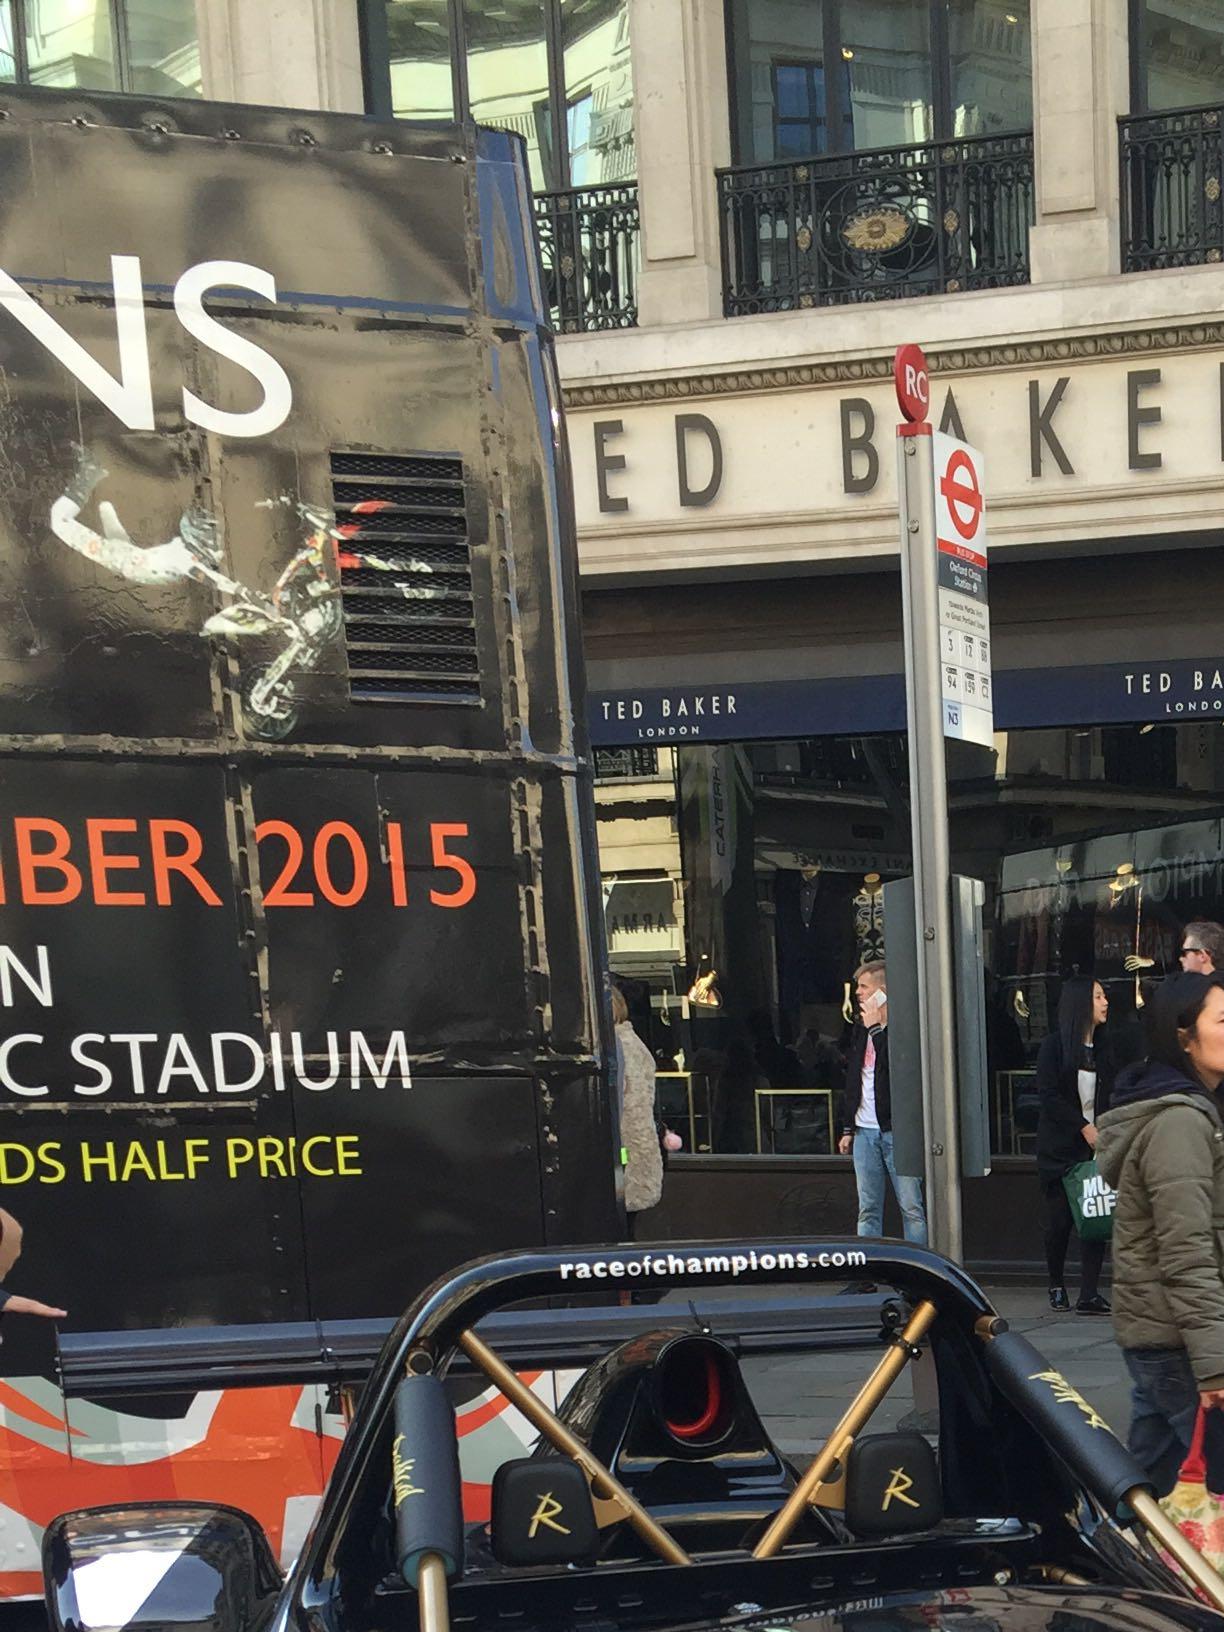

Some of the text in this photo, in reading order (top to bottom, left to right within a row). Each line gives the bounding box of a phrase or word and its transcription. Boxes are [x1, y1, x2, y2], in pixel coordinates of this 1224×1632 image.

[905, 364, 928, 404] RC
[593, 413, 723, 513] ED
[1125, 672, 1172, 695] TED
[602, 694, 739, 721] TED BAKER
[638, 725, 701, 738] LONDON
[0, 816, 477, 908] BER 2015
[0, 944, 54, 1008] N
[70, 1030, 413, 1096] STADIUM
[81, 1138, 210, 1182] HALF
[227, 1135, 363, 1180] PRICE
[1082, 1175, 1120, 1199] MU
[559, 1247, 868, 1280] raceofchampions.com
[880, 1466, 922, 1512] R
[527, 1490, 572, 1539] R
